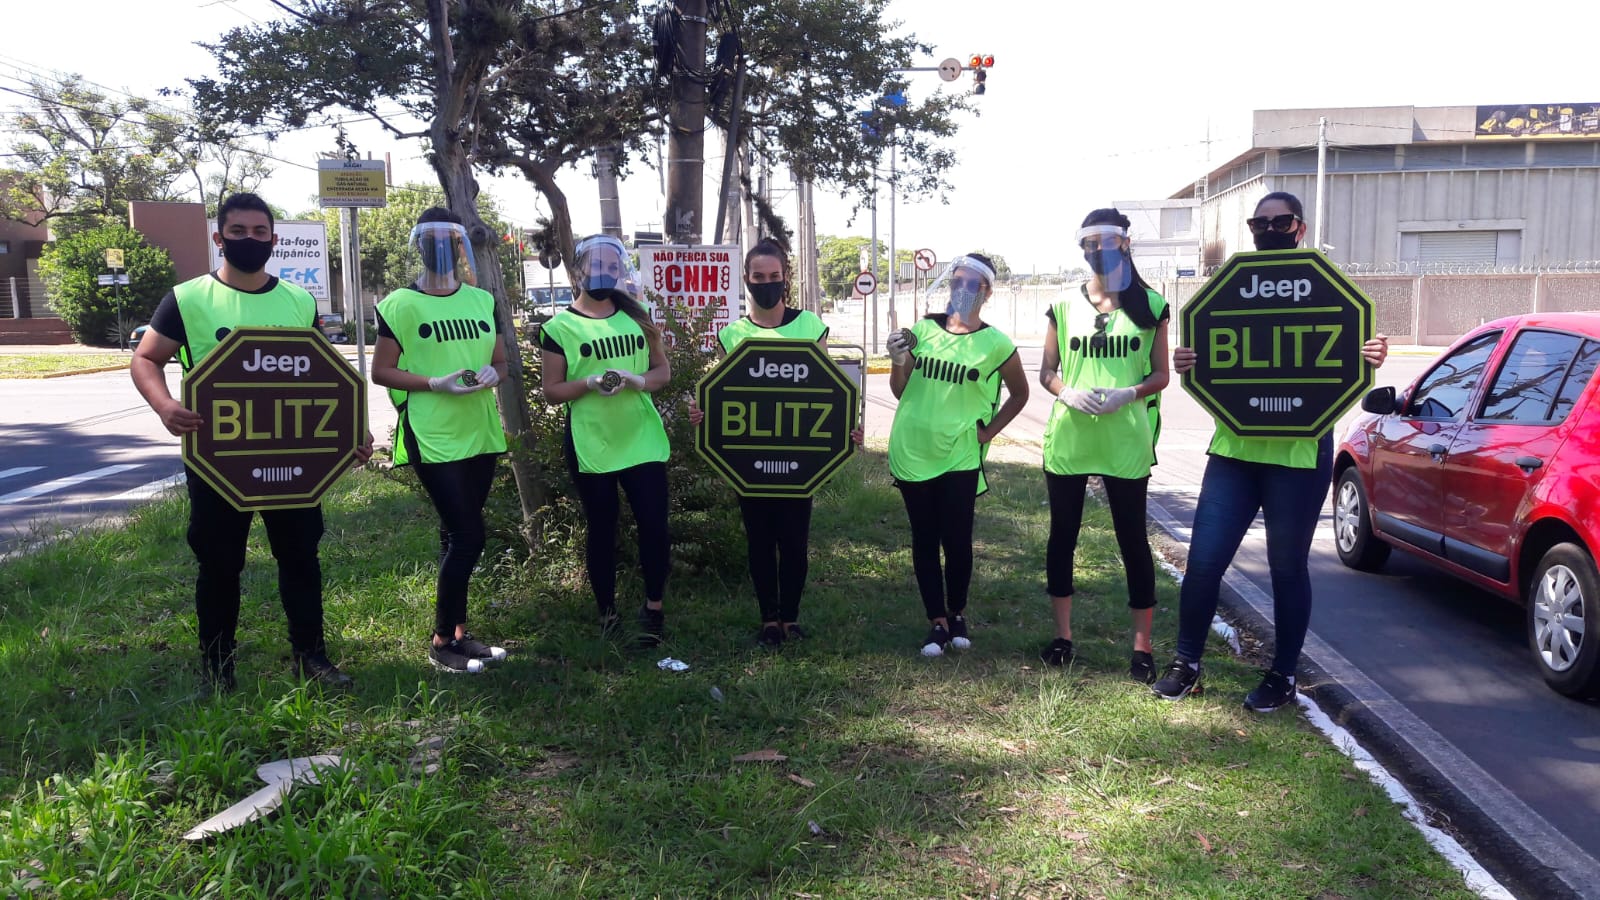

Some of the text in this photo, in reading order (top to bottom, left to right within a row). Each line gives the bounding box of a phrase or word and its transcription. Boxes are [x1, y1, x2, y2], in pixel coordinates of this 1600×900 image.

[653, 250, 729, 262] NÃO PERCA SUA
[665, 264, 718, 292] CNH
[1239, 274, 1312, 302] Jeep
[1209, 324, 1343, 369] BLITZ
[242, 349, 311, 376] Jeep
[748, 357, 809, 382] Jeep
[212, 399, 339, 441] BLITZ
[721, 401, 833, 438] BLITZ
